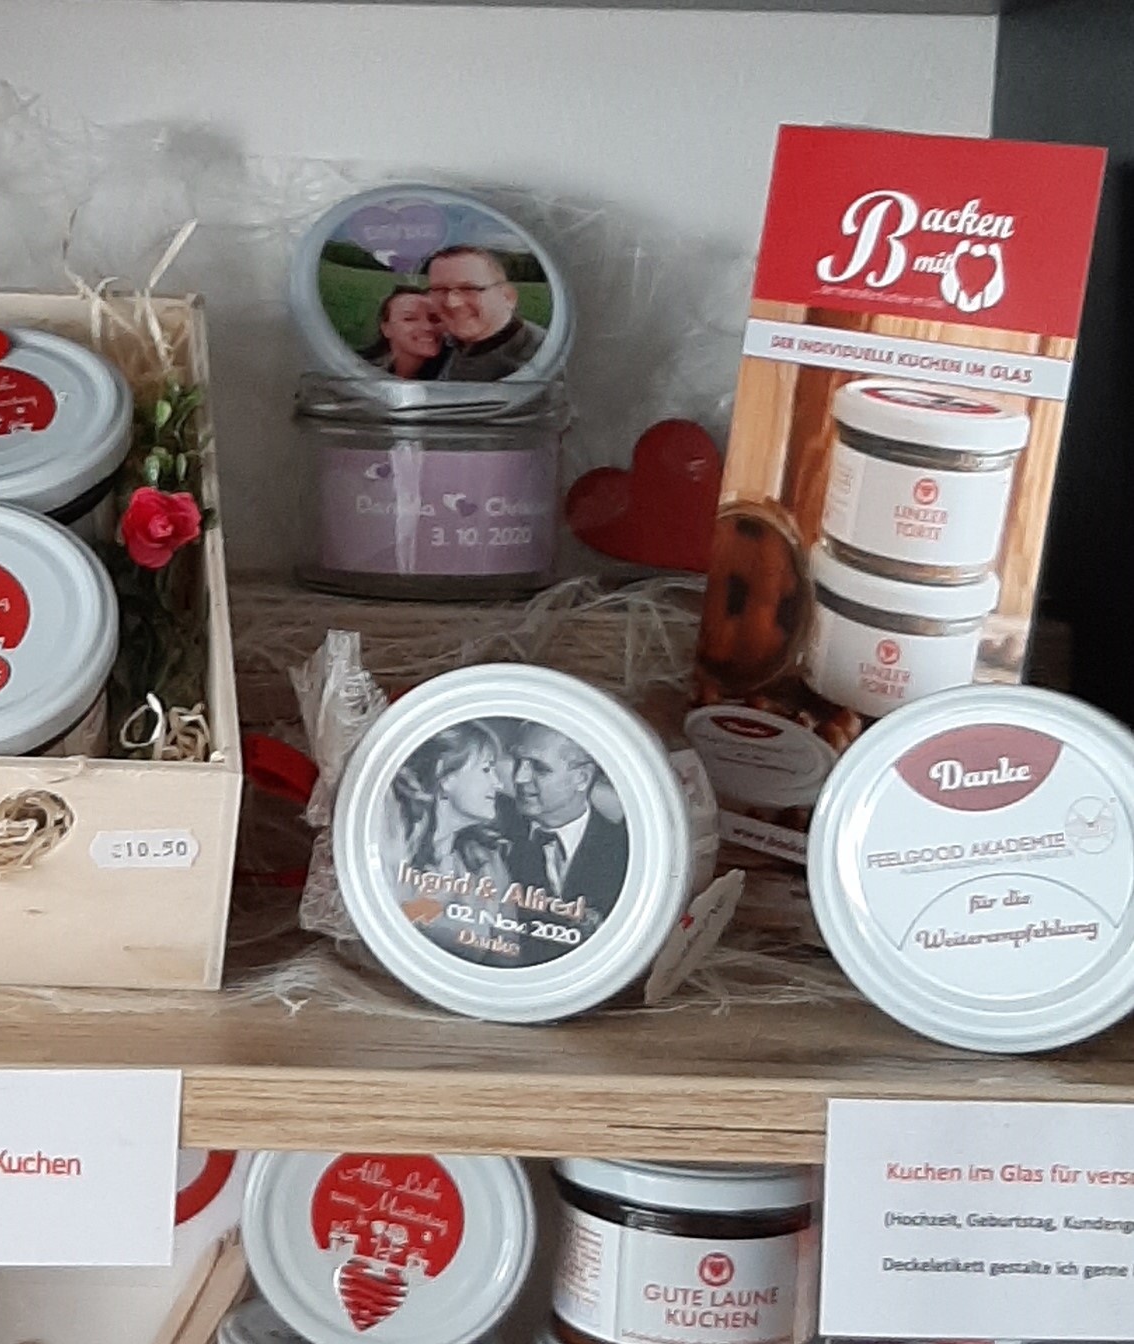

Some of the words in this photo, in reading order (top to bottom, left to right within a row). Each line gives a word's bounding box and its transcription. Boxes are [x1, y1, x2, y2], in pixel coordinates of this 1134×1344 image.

[817, 189, 1015, 288] Backen
[912, 252, 954, 275] mit
[772, 335, 793, 350] DER
[798, 338, 895, 366] INDIVIDUELLE
[899, 353, 961, 375] KUCHEN
[966, 362, 985, 379] IM
[990, 364, 1033, 384] GLAS
[928, 757, 1033, 793] Danke
[971, 832, 1066, 859] AKADEMIE
[398, 859, 471, 898] Ingrid
[475, 875, 497, 900] &
[501, 882, 588, 921] Alfred
[446, 902, 475, 922] 02
[530, 920, 581, 945] 2020
[886, 1163, 962, 1182] Kuchen
[968, 1165, 995, 1182] im
[1000, 1164, 1043, 1184] Glas
[1050, 1164, 1081, 1184] für
[989, 1259, 1051, 1278] gestalte
[1055, 1260, 1079, 1276] ich
[643, 1283, 703, 1307] GUTE
[711, 1286, 779, 1308] LAUNE
[665, 1308, 759, 1329] KUCHEN
